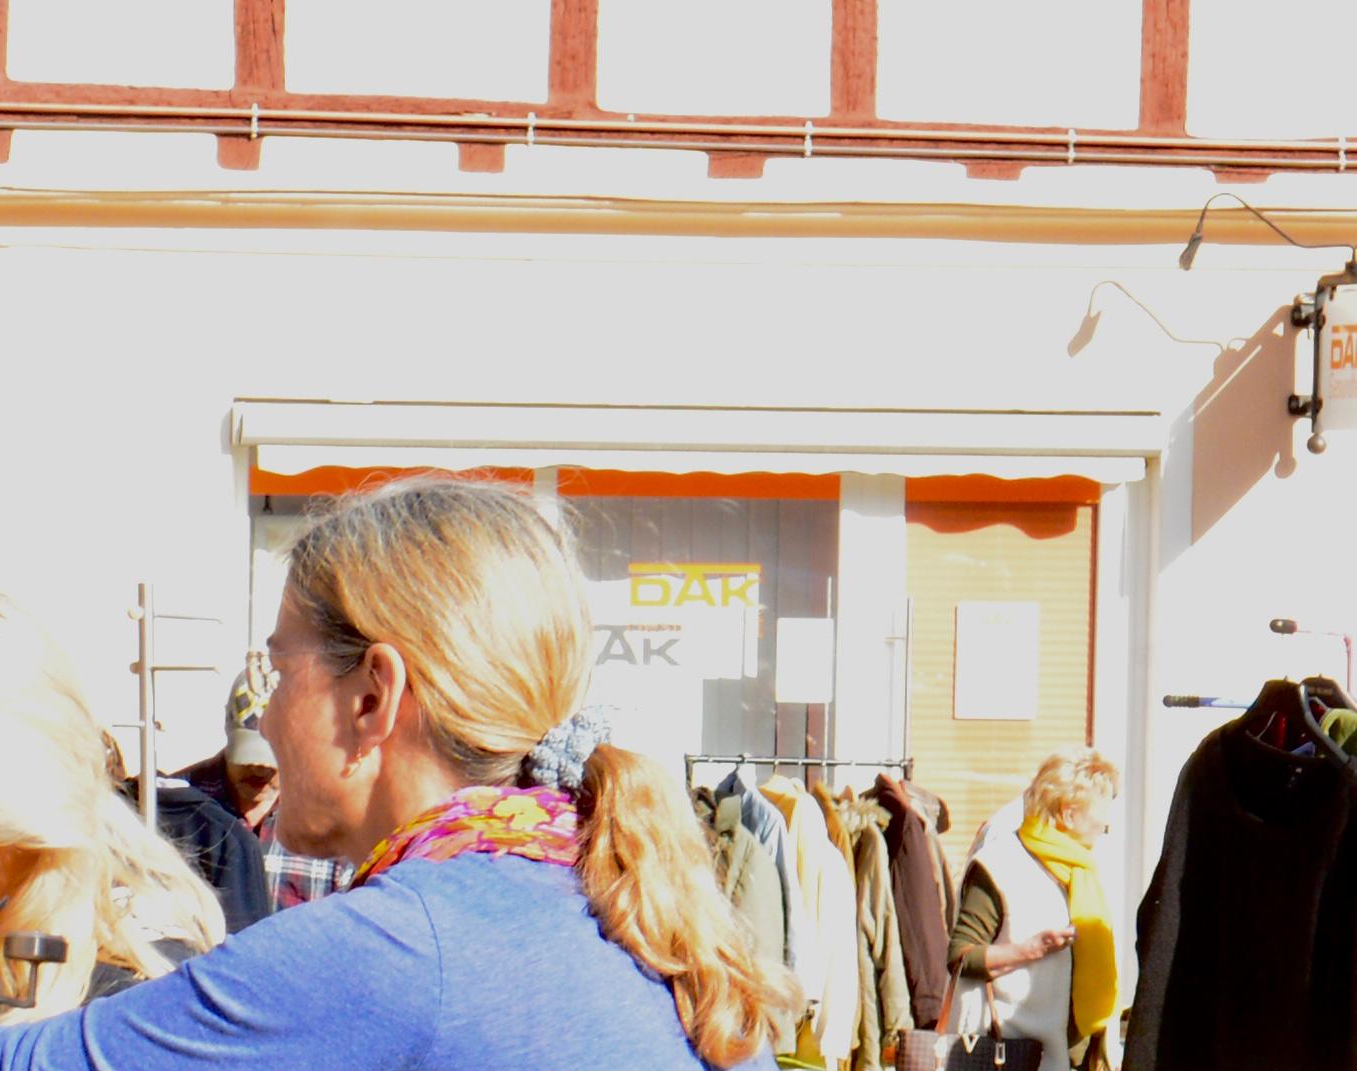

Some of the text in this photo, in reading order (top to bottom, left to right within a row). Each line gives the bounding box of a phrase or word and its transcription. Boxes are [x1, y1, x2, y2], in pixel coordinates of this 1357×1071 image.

[1330, 325, 1357, 369] DA
[628, 563, 761, 607] DAK
[593, 624, 681, 665] AK
